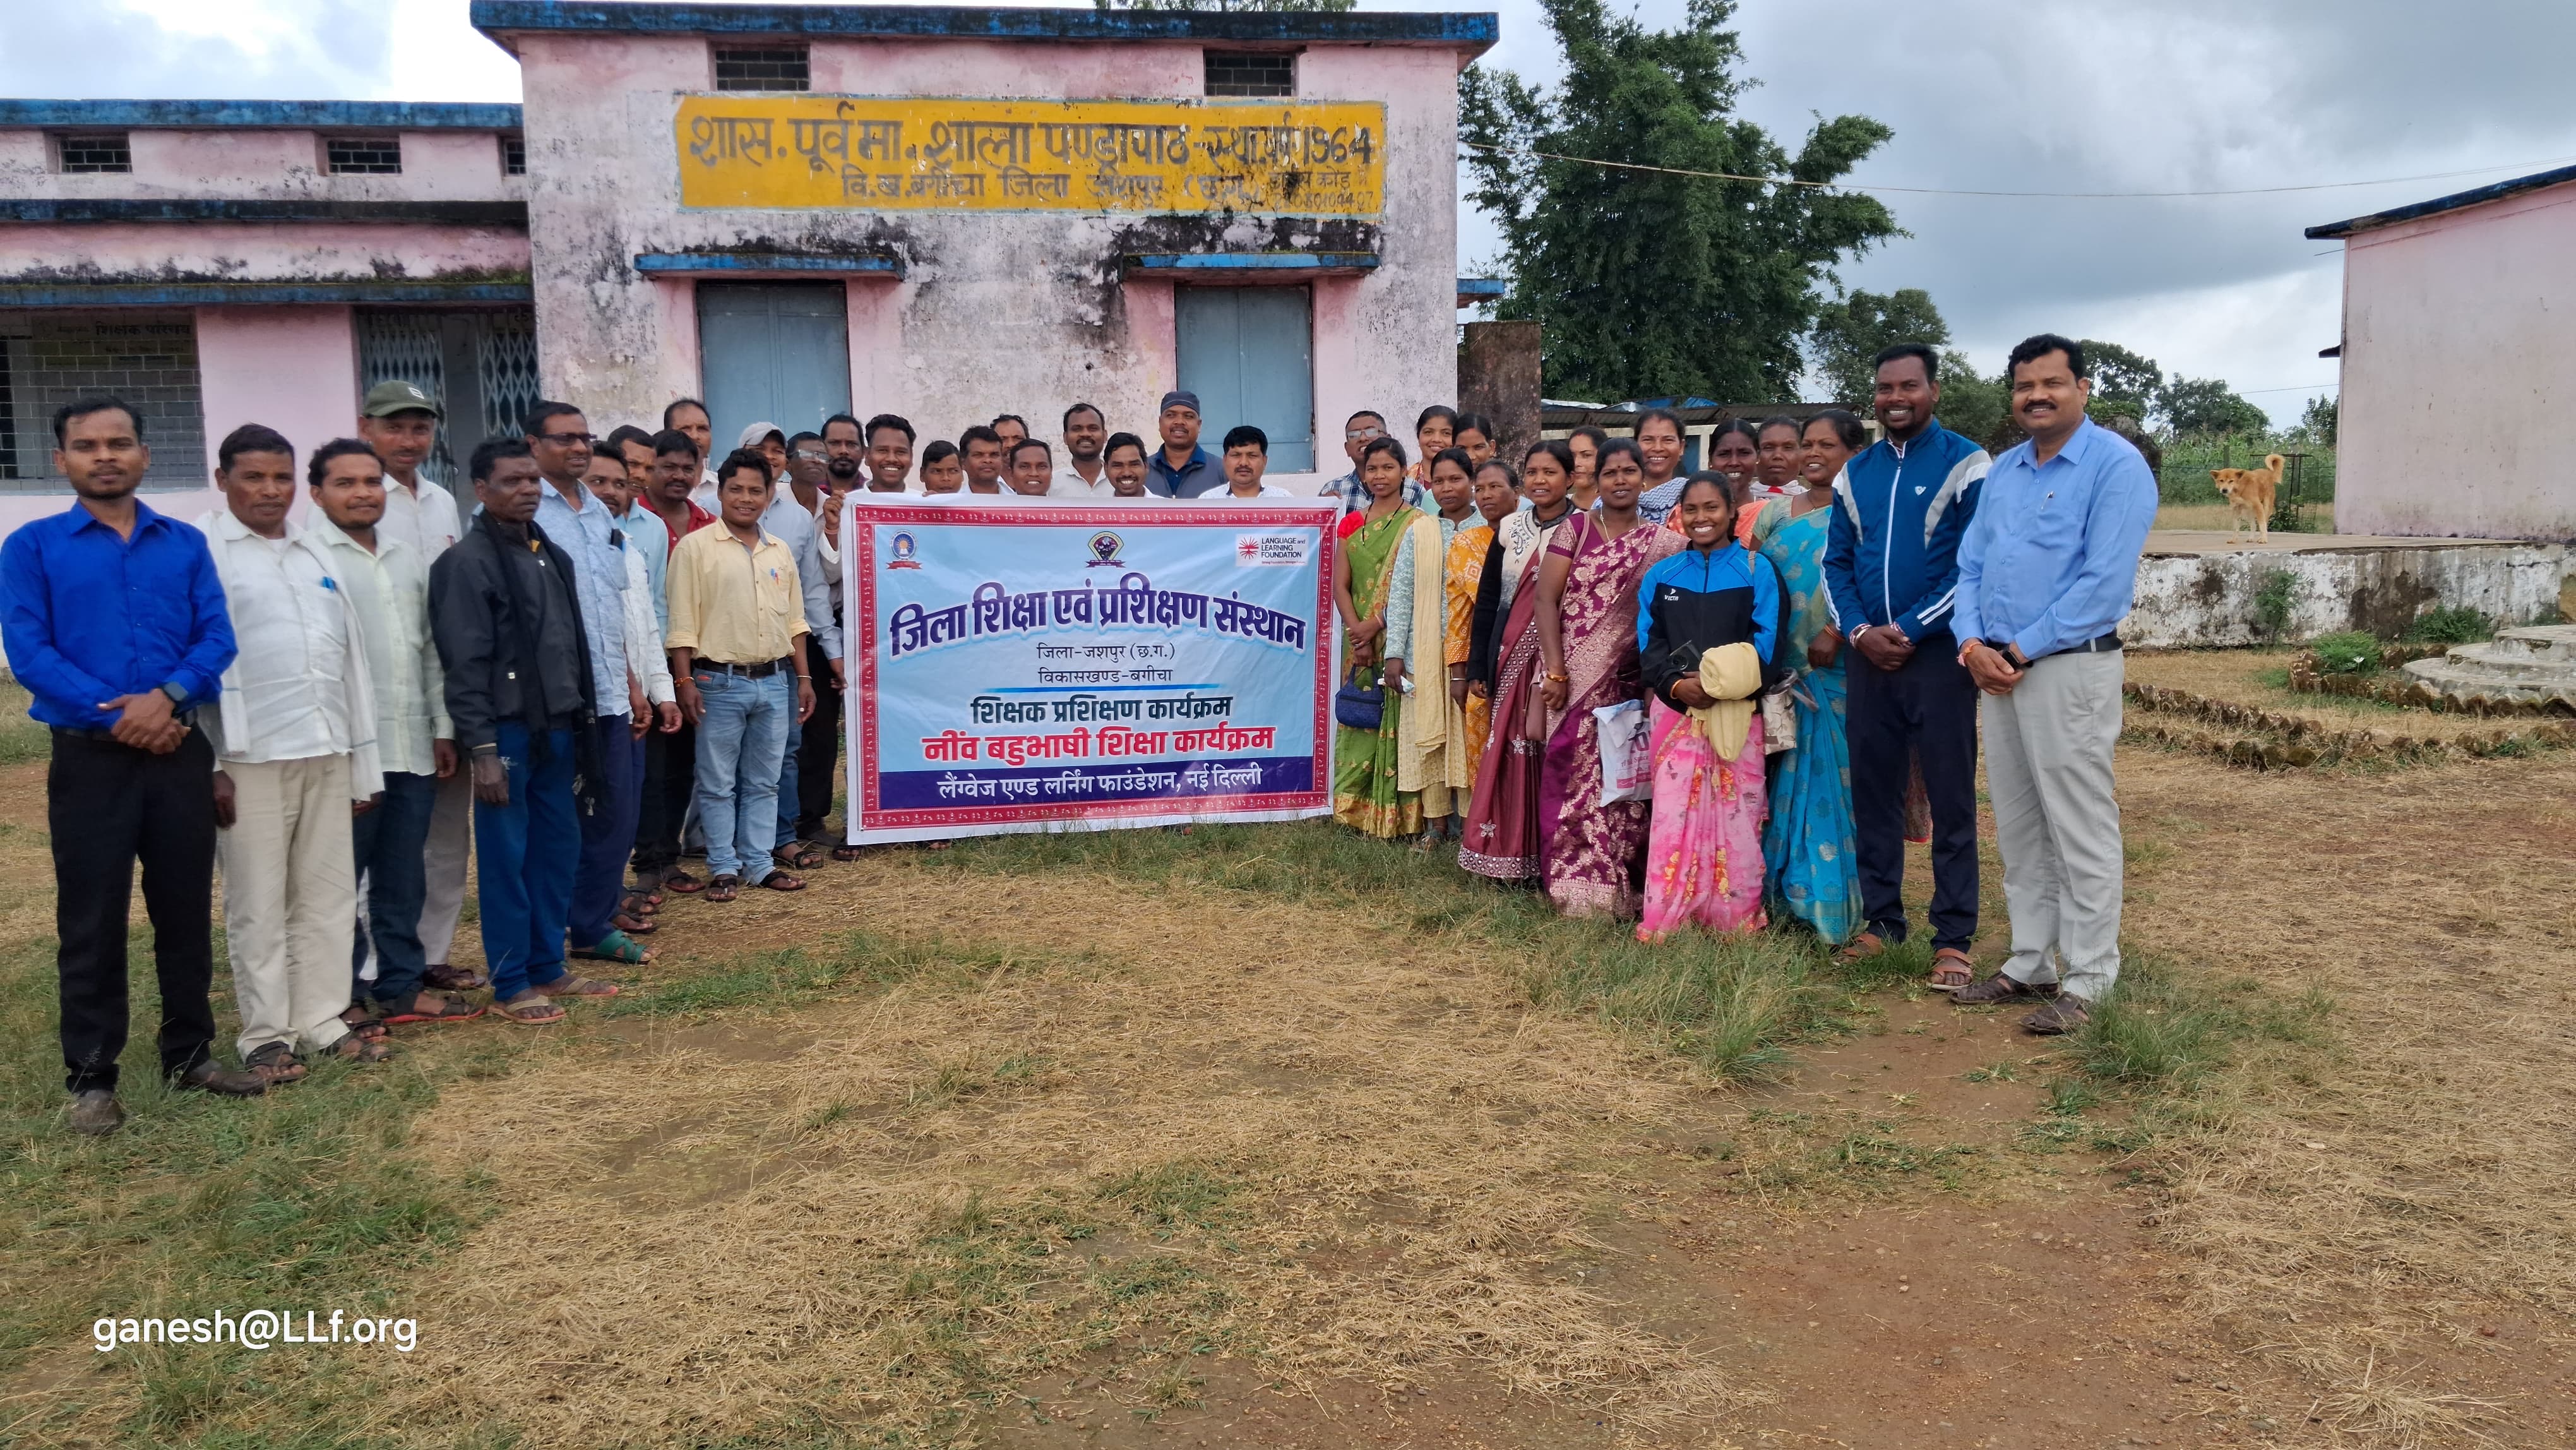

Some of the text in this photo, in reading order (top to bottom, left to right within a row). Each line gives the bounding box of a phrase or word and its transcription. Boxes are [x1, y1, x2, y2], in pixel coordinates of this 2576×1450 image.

[689, 116, 787, 167] शास.
[924, 120, 1034, 167] शाला
[996, 165, 1071, 202] जिला
[890, 572, 1306, 657] जिला शिक्षा एवं प्रशिक्षण संस्थान
[1037, 641, 1176, 662] जिला-जशपुर (छ.ग.)
[1038, 664, 1172, 683] विकासखण्ड-बगीचा
[970, 692, 1233, 724] शिक्षक प्रशिक्षण कार्यक्रम
[922, 721, 1275, 766] नींव बहुभाषी शिक्षा कार्यक्रम
[937, 762, 1263, 800] लैंग्वेज एण्ड लर्निंग फाउंडेशन, नई दिल्ली
